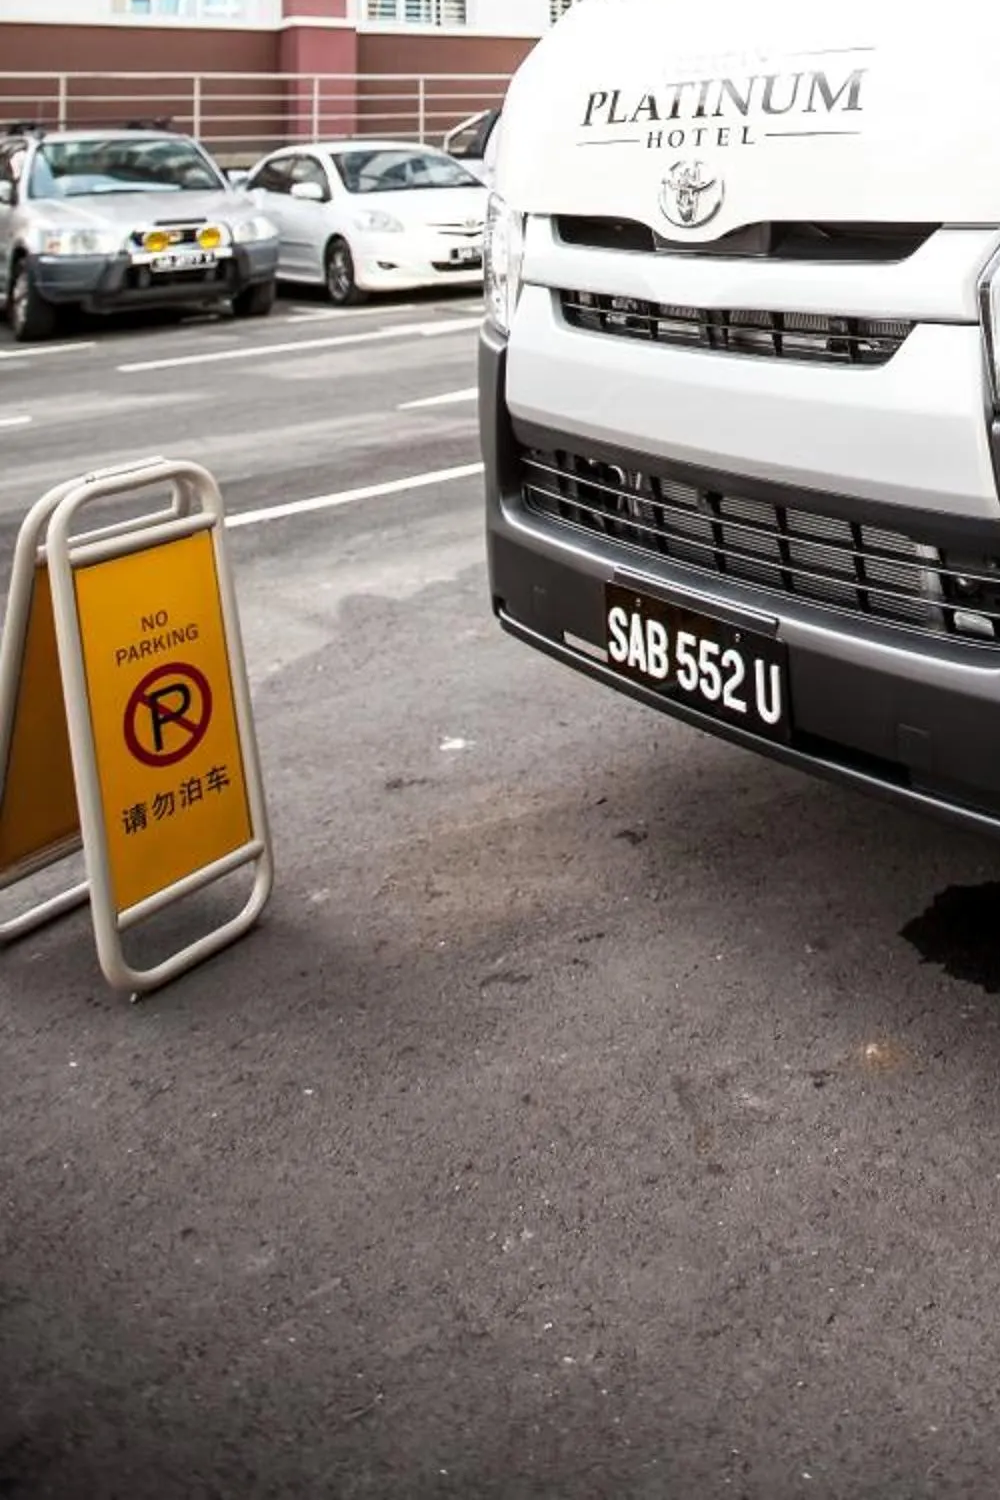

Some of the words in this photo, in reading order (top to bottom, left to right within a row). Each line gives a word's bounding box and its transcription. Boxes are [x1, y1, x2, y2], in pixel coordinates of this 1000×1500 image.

[580, 68, 869, 127] PLATINUM
[646, 125, 757, 149] HOTEL
[115, 623, 200, 667] PARKING
[141, 610, 169, 633] NO
[608, 606, 669, 680] SAB
[676, 630, 747, 713] 552
[754, 659, 782, 725] U
[121, 764, 231, 836] 请勿泊车
